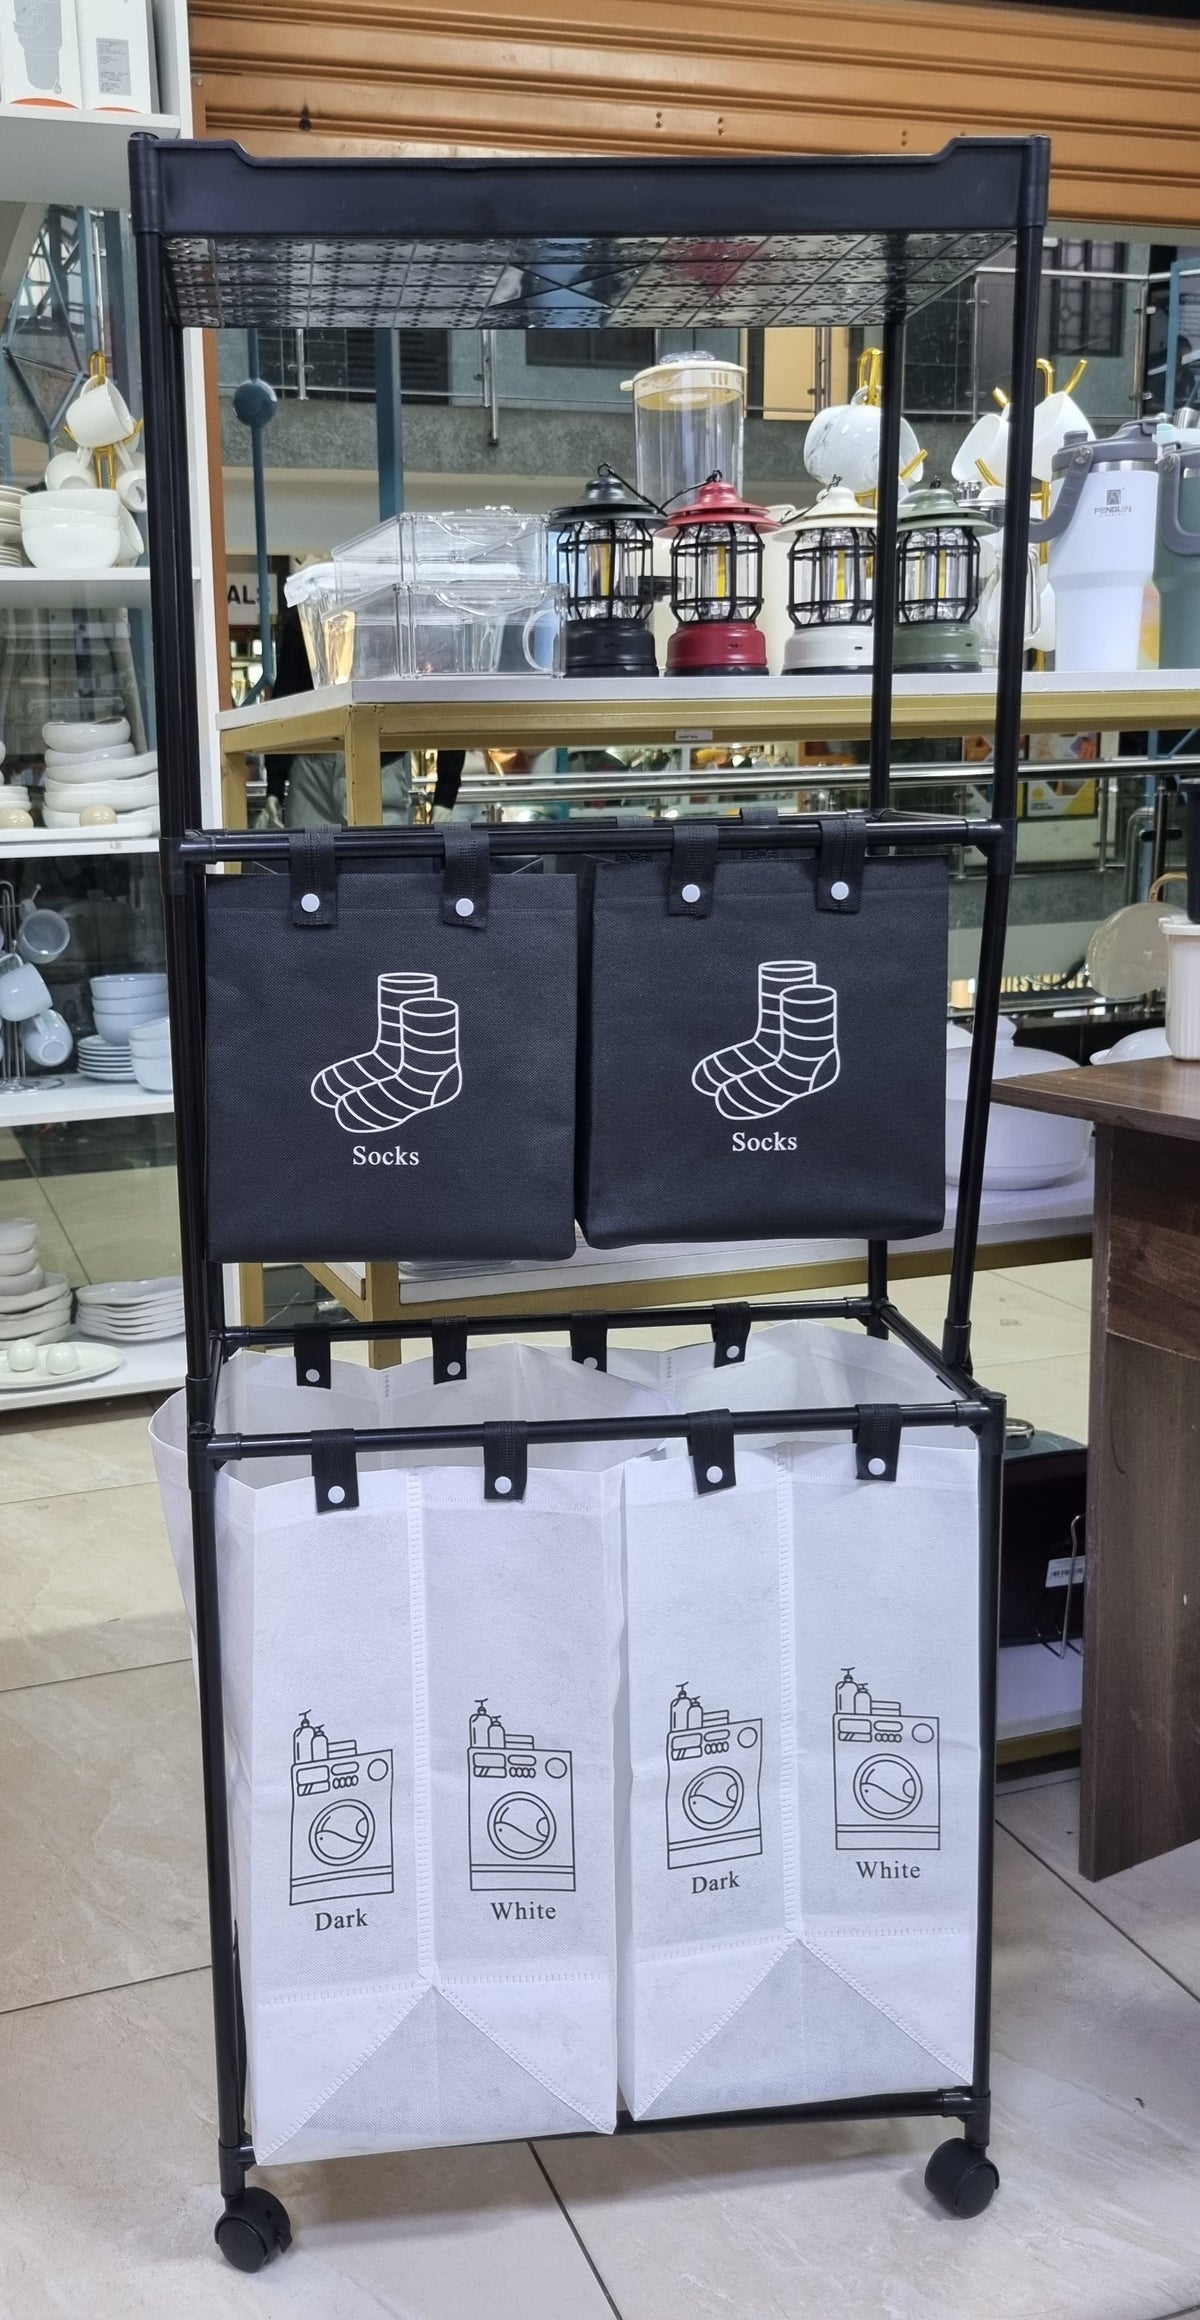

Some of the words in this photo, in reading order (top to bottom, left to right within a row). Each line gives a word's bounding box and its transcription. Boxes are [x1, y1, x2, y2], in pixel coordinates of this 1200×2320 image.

[732, 1131, 798, 1152] Socks
[352, 1145, 420, 1166] Socks
[855, 1860, 921, 1879] White
[691, 1870, 740, 1895] Dark
[315, 1908, 369, 1932] Dark
[490, 1901, 557, 1921] White
